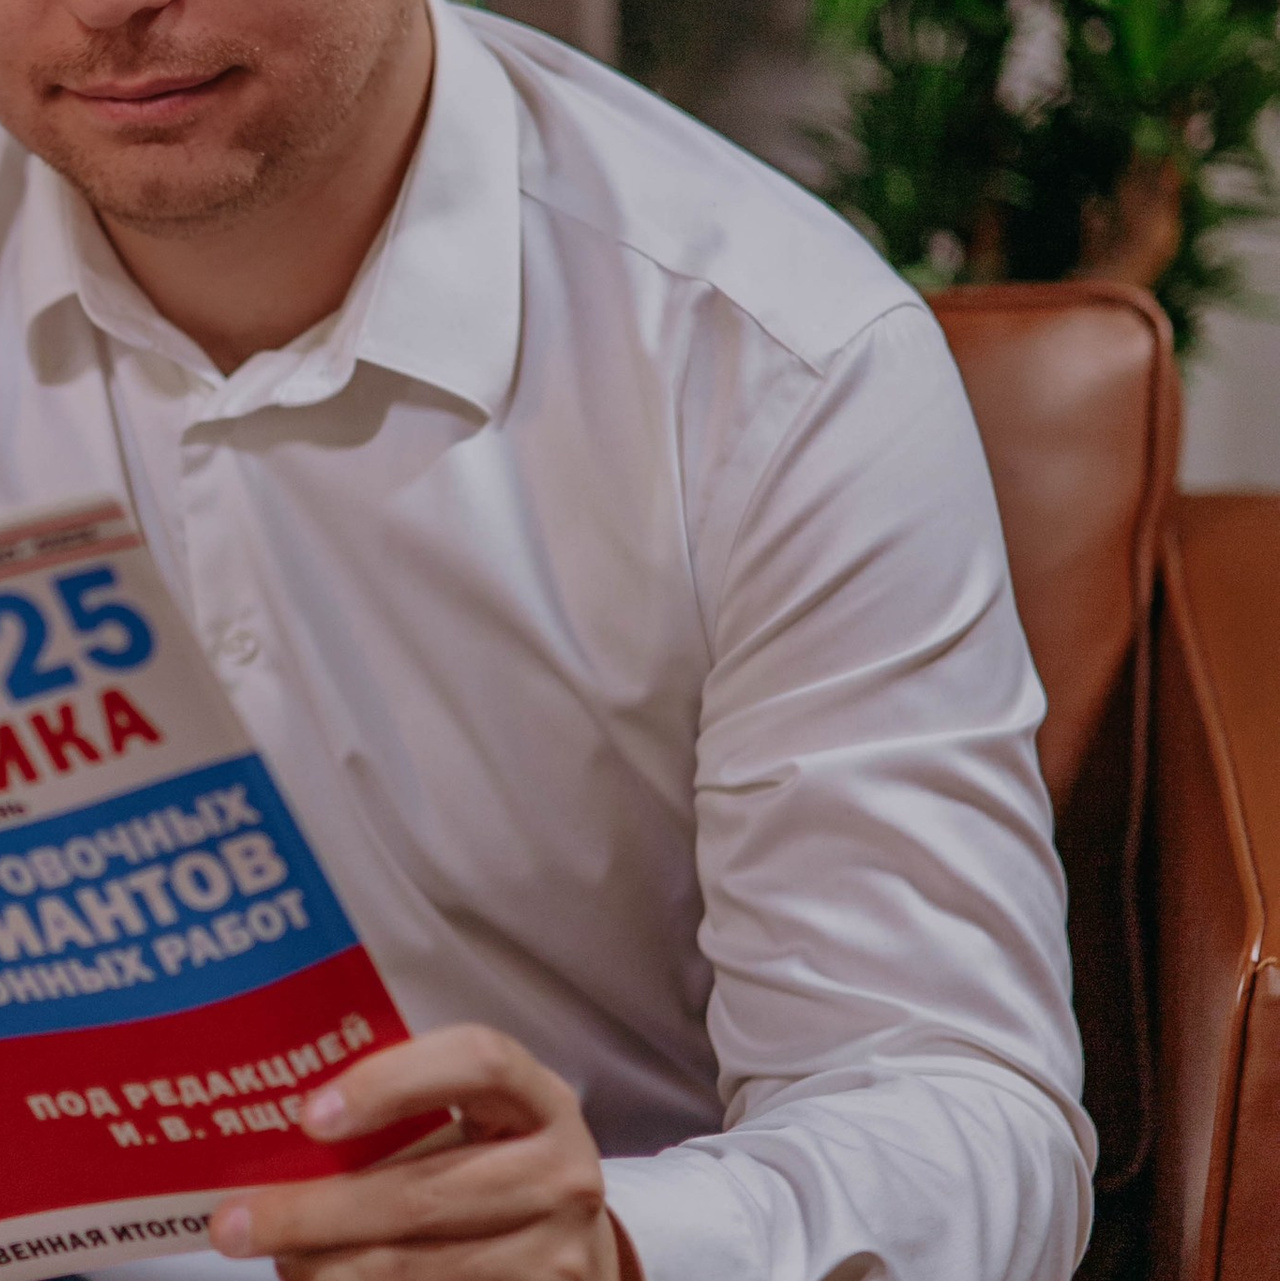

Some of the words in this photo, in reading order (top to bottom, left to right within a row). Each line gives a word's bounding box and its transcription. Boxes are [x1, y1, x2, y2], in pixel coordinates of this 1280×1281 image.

[152, 889, 309, 976] РАБОТ
[26, 1087, 119, 1121] ПОД
[121, 1011, 375, 1111] РЕДАКЦИЕЙ
[158, 1116, 206, 1143] В.
[212, 1094, 307, 1136] ЯЩЕ
